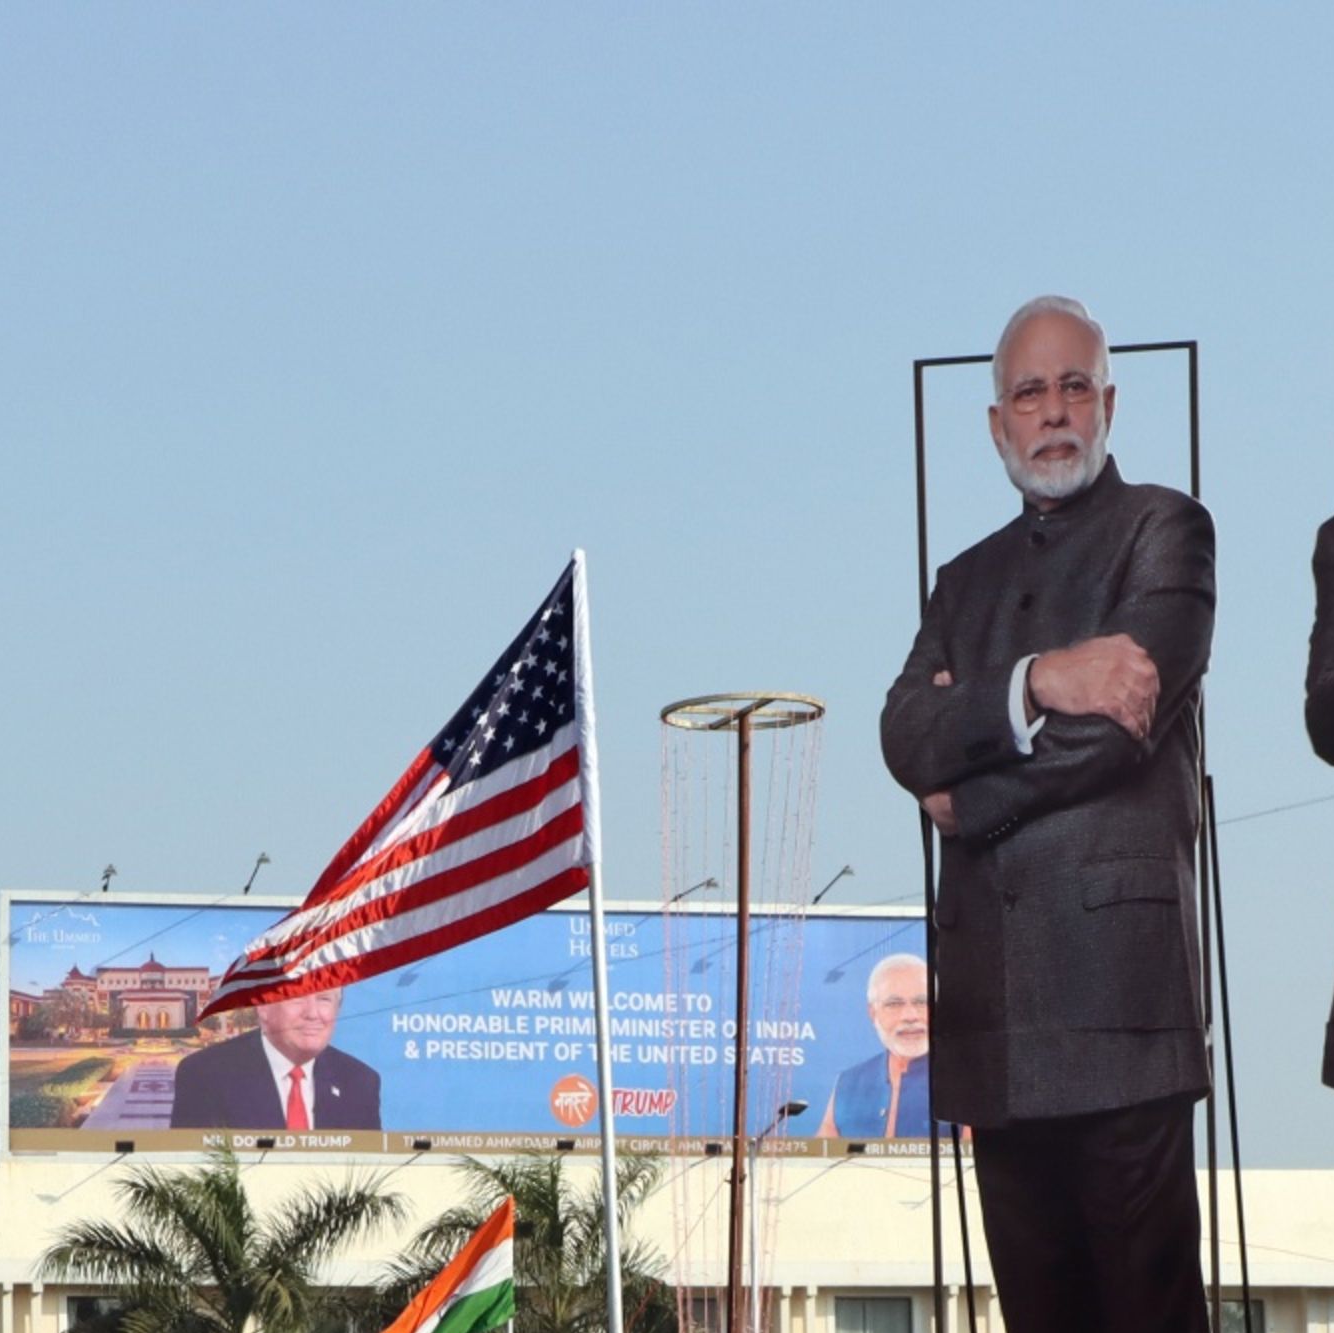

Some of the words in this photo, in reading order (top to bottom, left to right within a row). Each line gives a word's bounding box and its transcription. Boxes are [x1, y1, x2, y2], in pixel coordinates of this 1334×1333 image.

[491, 989, 562, 1009] WARM
[683, 994, 712, 1012] TO
[392, 1013, 529, 1034] HONORABLE
[611, 1018, 716, 1039] MINISTER
[756, 1021, 816, 1041] INDIA
[405, 1040, 420, 1060] &
[426, 1040, 549, 1061] PRESIDENT
[554, 1042, 582, 1061] OF
[638, 1044, 717, 1065] UNITED
[299, 1135, 352, 1148] TRUMP
